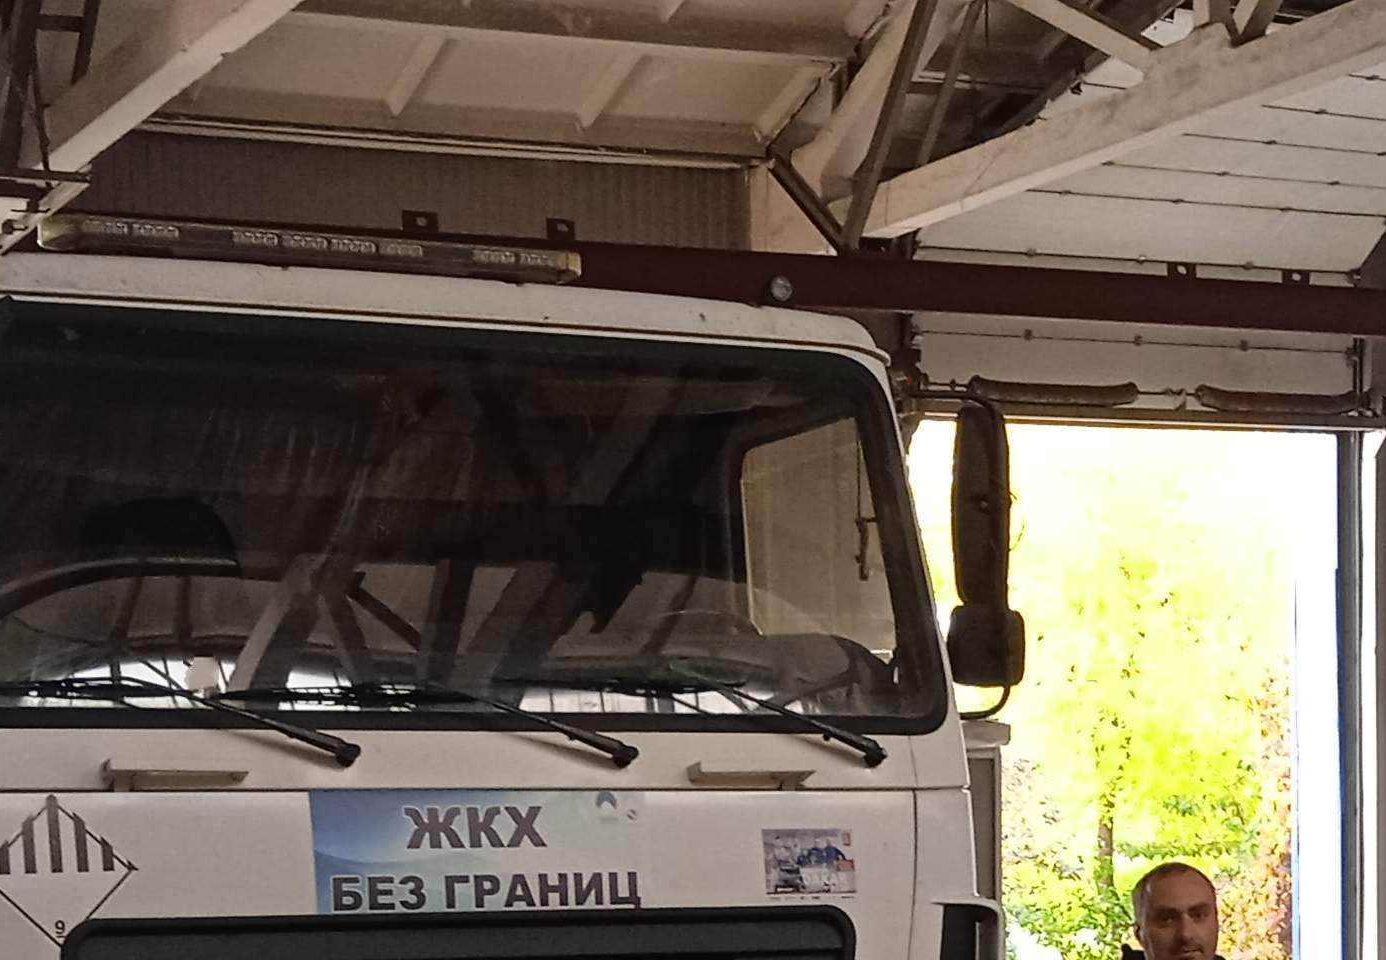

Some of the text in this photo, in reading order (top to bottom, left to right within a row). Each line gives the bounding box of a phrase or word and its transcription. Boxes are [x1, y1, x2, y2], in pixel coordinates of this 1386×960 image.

[403, 805, 547, 850] ЖКХ
[332, 871, 642, 912] БЕЗ ГРАНИЦ
[55, 919, 66, 935] 9
